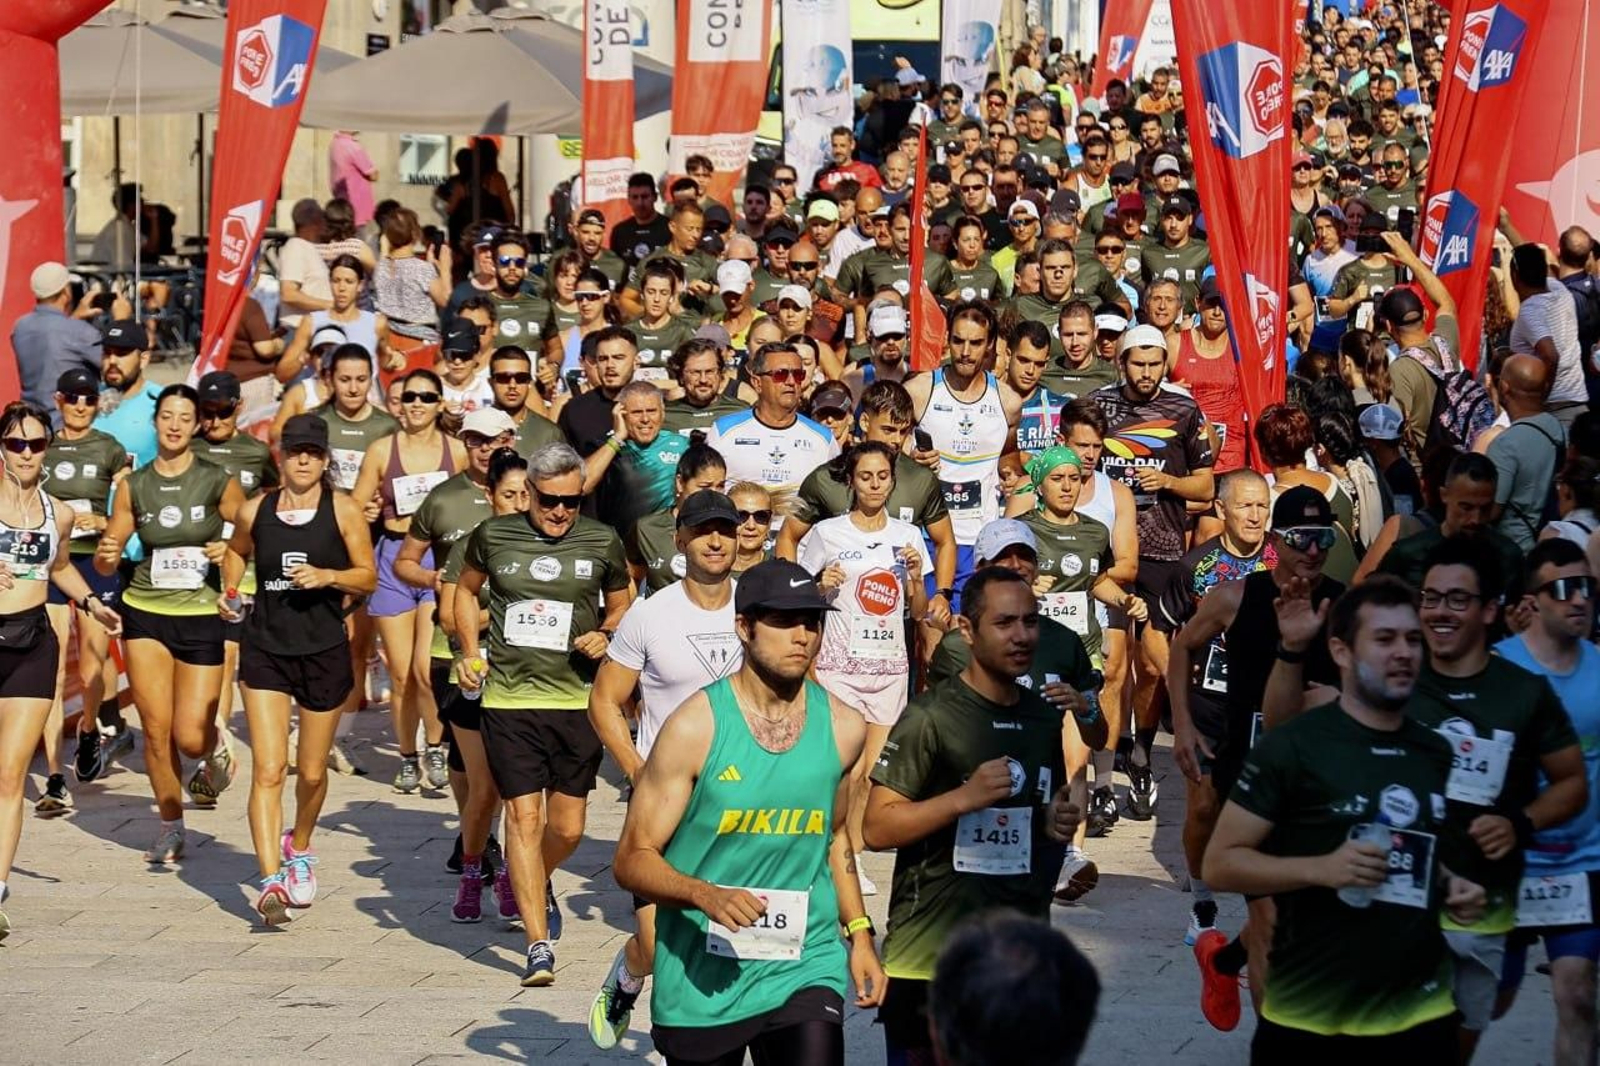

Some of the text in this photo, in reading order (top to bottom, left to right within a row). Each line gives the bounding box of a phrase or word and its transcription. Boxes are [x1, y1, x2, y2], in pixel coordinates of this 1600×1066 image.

[606, 7, 630, 45] DE
[1483, 49, 1514, 81] AXA
[1439, 234, 1468, 267] AXA
[944, 491, 969, 502] 365
[10, 543, 38, 556] 213
[163, 559, 198, 570] 1583
[863, 579, 897, 598] PONLE
[861, 589, 894, 607] FRENO
[1044, 605, 1077, 617] 1542
[862, 629, 894, 641] 1124
[717, 808, 824, 835] BIKILA
[972, 828, 1020, 845] 1415
[1524, 884, 1573, 901] 1127
[752, 912, 788, 930] 18
